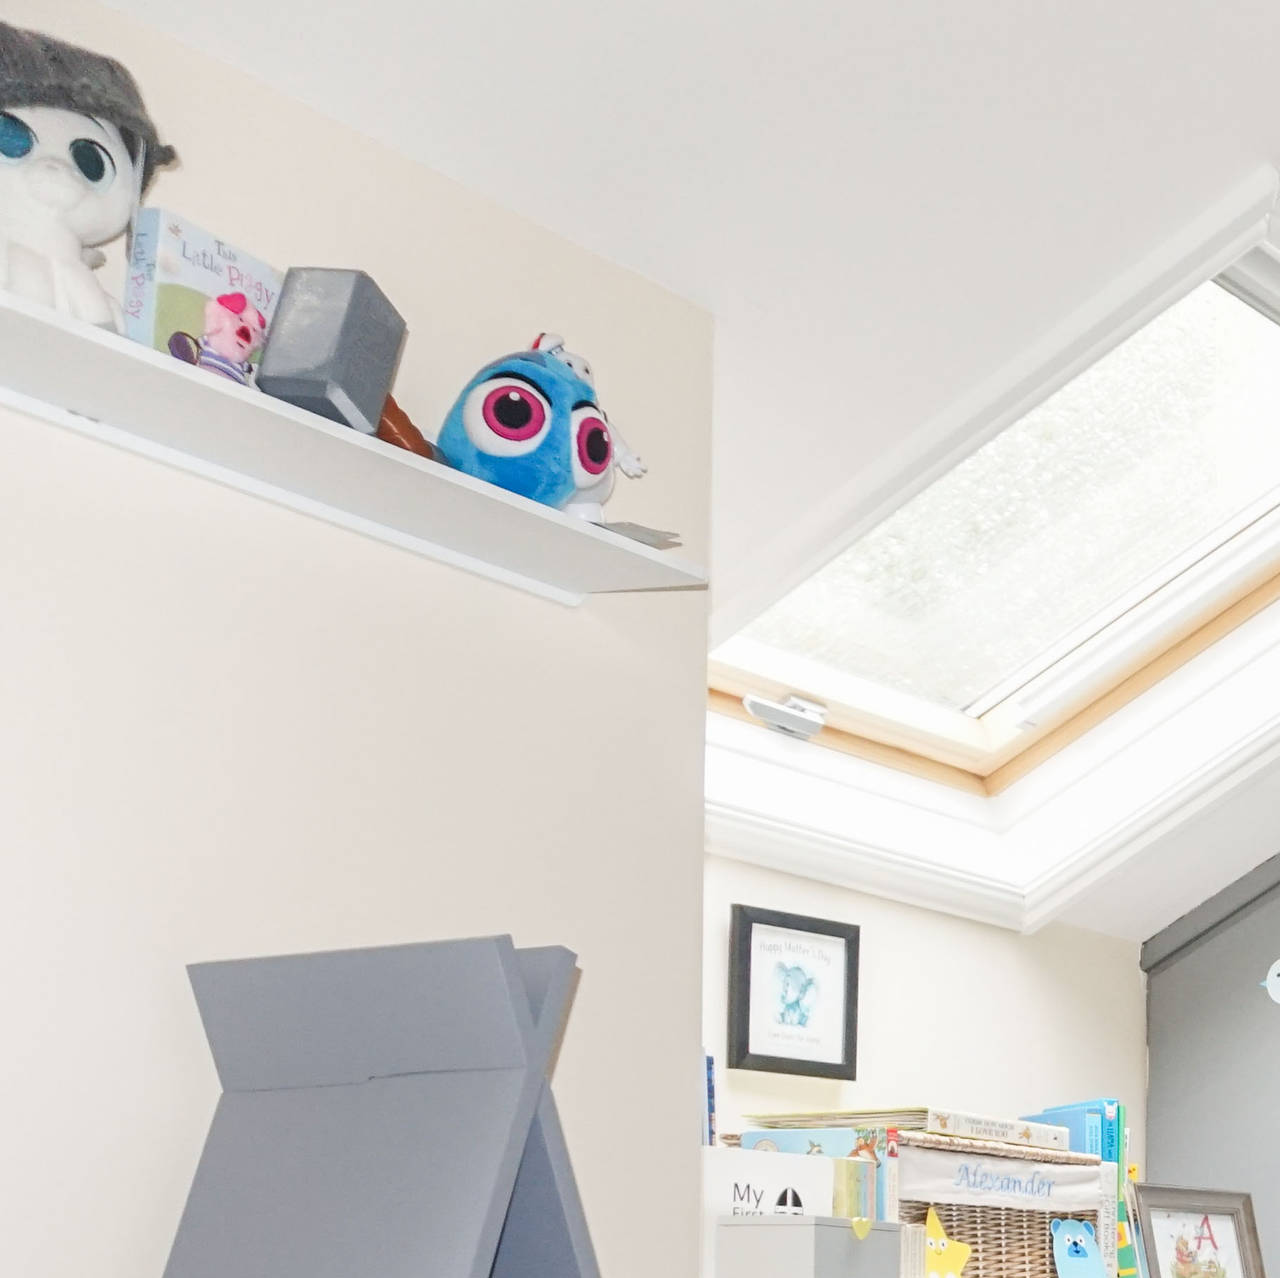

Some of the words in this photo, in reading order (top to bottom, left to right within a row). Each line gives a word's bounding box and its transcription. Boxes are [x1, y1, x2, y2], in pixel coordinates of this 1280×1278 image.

[732, 1182, 764, 1209] My
[954, 1162, 1056, 1197] Alexander
[1193, 1213, 1219, 1251] A
